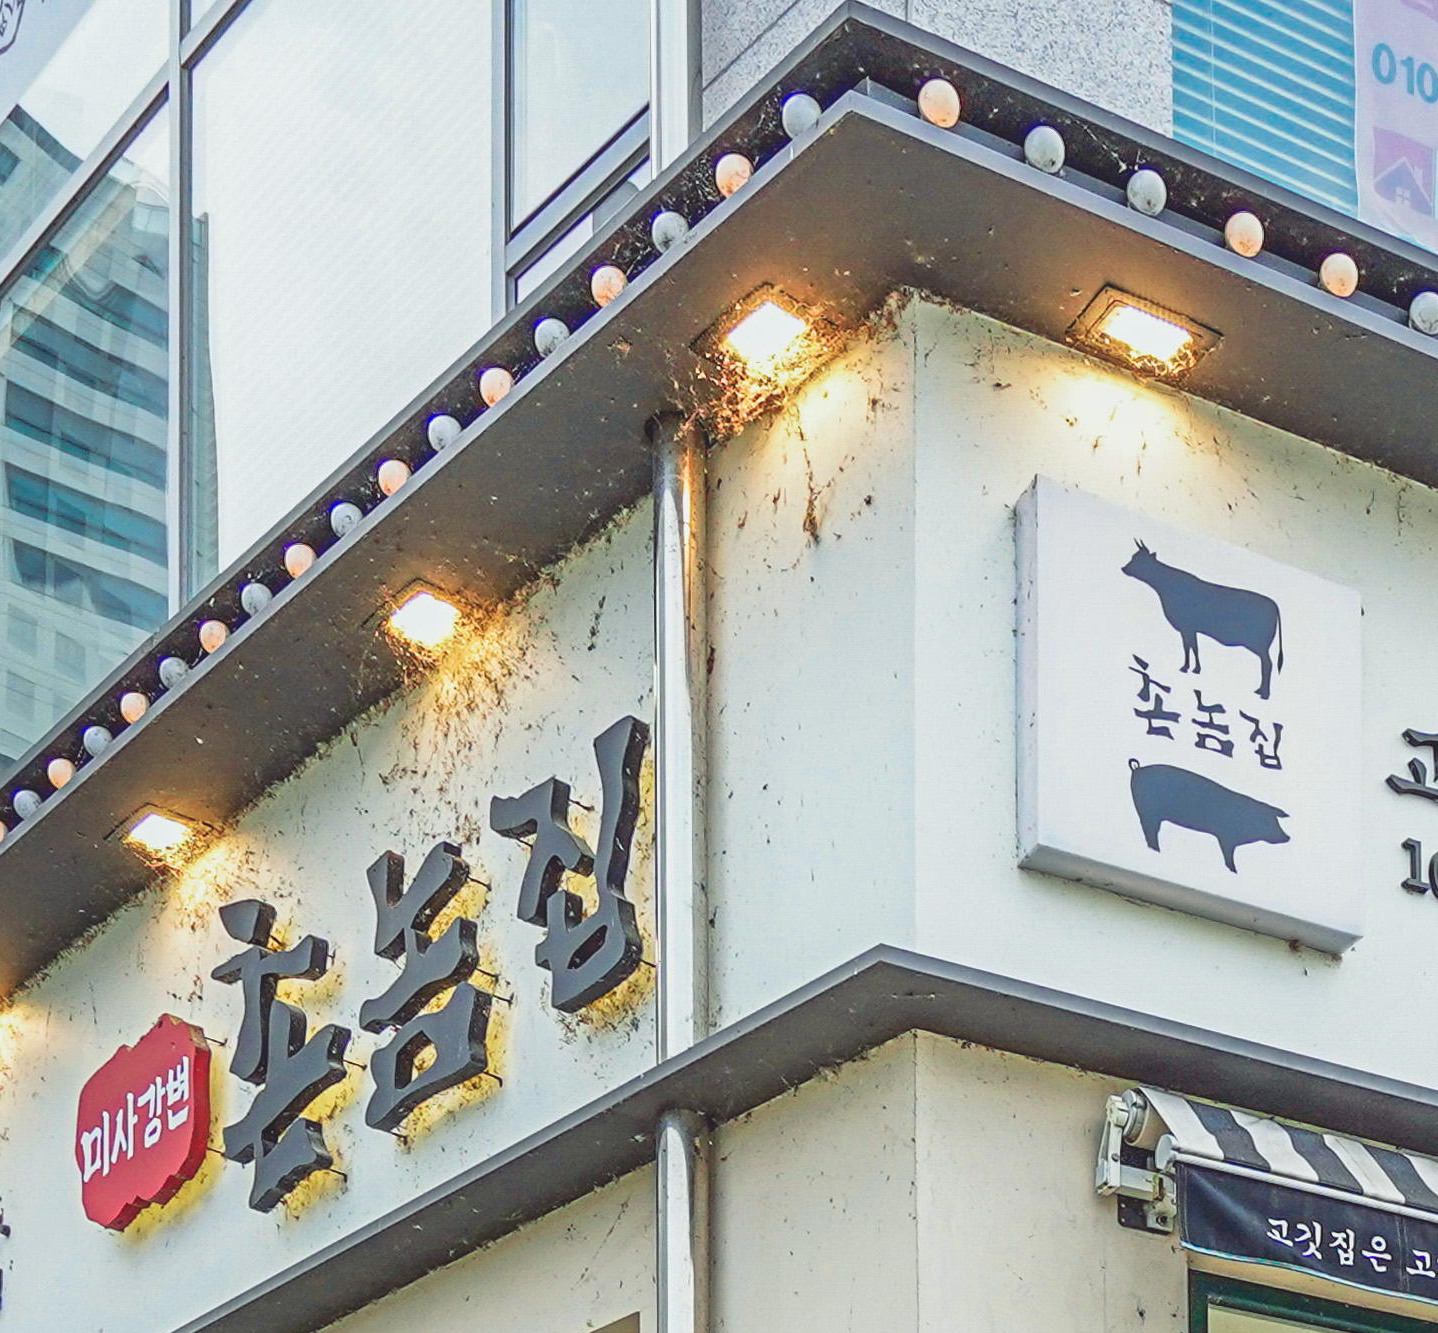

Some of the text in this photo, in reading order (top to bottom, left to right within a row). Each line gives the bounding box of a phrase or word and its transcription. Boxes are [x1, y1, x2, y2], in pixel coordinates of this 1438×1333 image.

[1128, 653, 1284, 770] 촌놈집
[210, 714, 650, 1214] 촌놈집
[80, 1054, 192, 1183] 미사강변
[1266, 1217, 1393, 1274] 고깃집은
